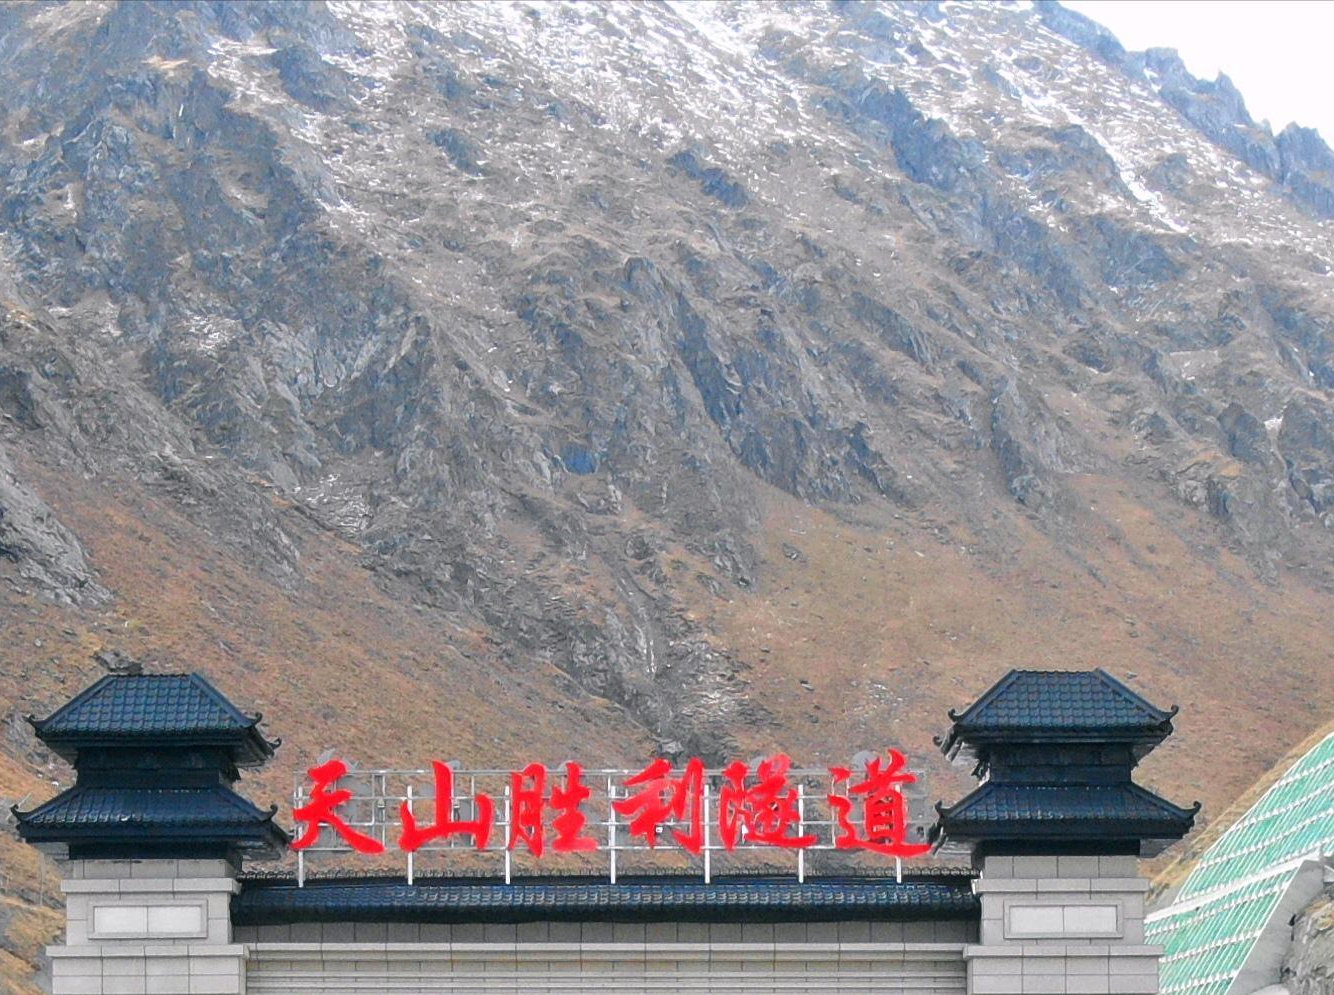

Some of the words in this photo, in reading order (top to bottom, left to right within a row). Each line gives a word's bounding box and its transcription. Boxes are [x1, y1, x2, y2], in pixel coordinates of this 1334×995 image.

[290, 747, 932, 858] 天山胜利隧道
